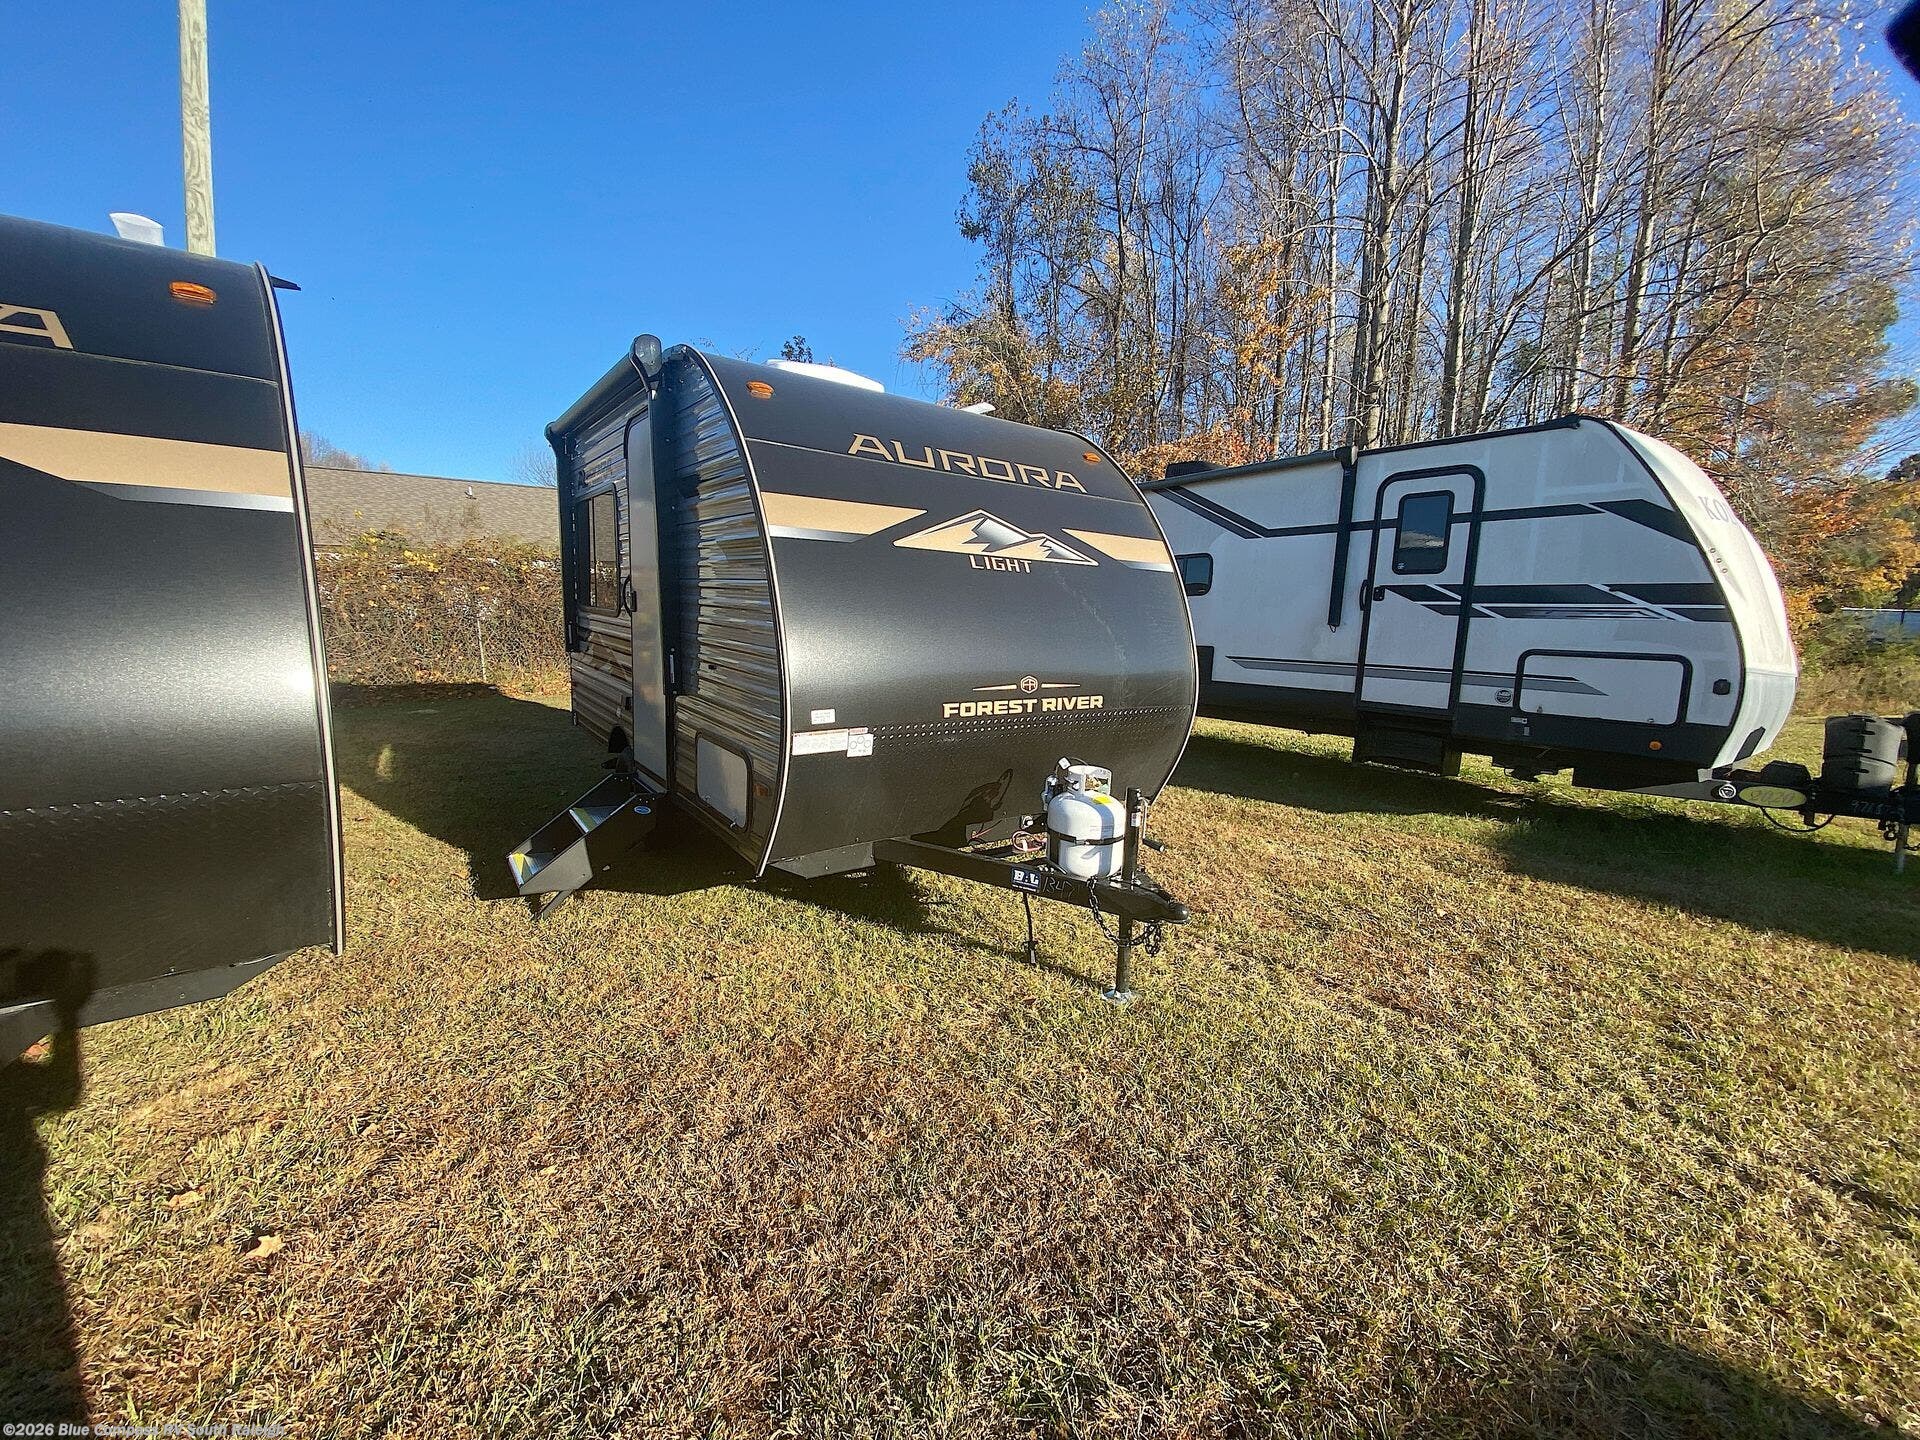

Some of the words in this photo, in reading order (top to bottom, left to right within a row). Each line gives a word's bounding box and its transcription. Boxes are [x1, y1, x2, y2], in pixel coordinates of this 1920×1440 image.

[847, 432, 1089, 494] AURORA
[968, 554, 1032, 574] LIGHT
[942, 698, 1038, 718] FOREST
[1041, 694, 1104, 713] RIVER
